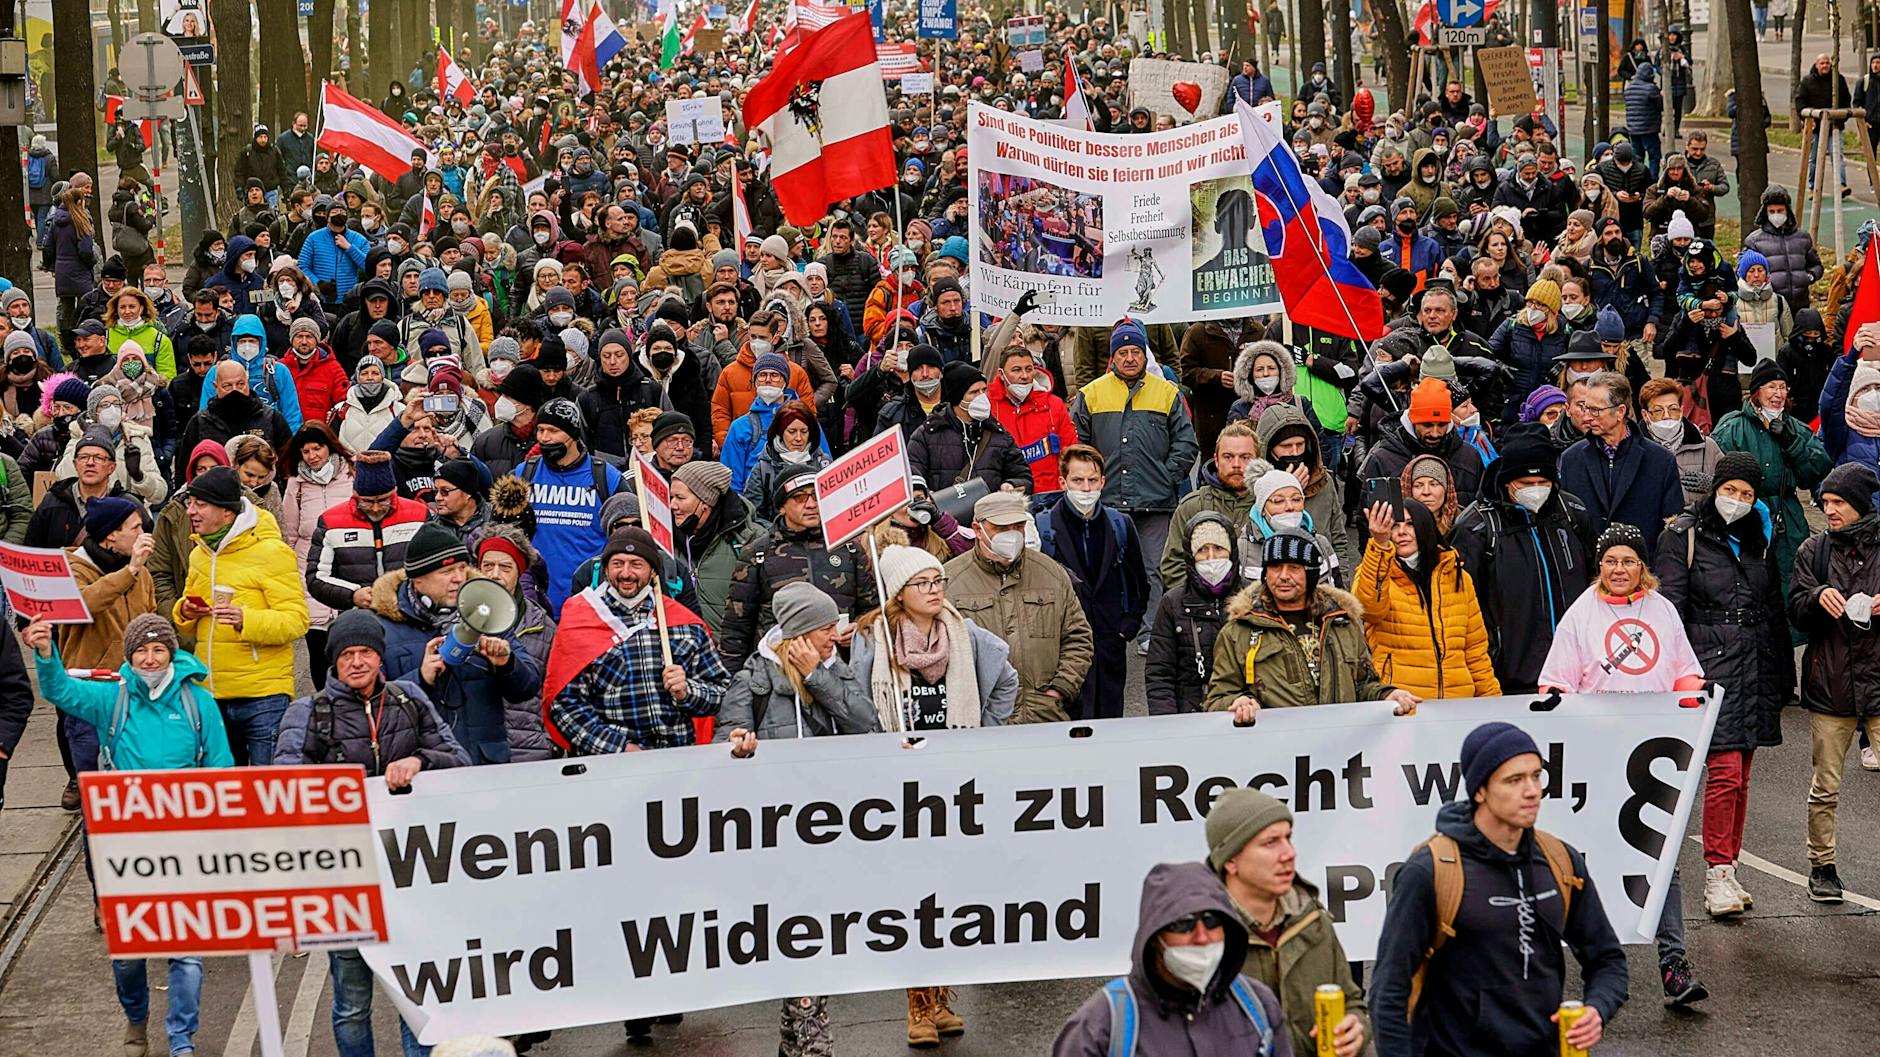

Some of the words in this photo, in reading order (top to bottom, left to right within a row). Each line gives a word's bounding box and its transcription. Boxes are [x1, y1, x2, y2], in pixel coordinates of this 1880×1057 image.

[922, 6, 946, 18] IMPF-
[922, 17, 953, 29] ZWANG!
[1445, 31, 1479, 43] 120m
[978, 111, 1005, 131] Sind
[1007, 120, 1026, 139] die
[1029, 128, 1082, 153] Politiker
[1085, 140, 1142, 158] bessere
[1147, 129, 1216, 156] Menschen
[1219, 122, 1239, 139] als
[996, 141, 1040, 166] Warum
[1043, 157, 1084, 178] dürfen
[1088, 166, 1109, 181] sie
[1113, 167, 1154, 182] feiern
[1158, 160, 1183, 178] und
[1187, 154, 1207, 171] wir
[1133, 194, 1161, 208] Friede
[1130, 209, 1164, 224] Freiheit
[1108, 226, 1186, 243] Selbstbestimmung
[1223, 247, 1249, 267] DAS
[980, 267, 1001, 285] Wir
[1003, 274, 1072, 295] Kämpfen
[1077, 282, 1102, 296] für
[1196, 265, 1276, 292] ERWACHEN
[1202, 287, 1271, 304] BEGINNT
[1089, 304, 1103, 317] !!!
[820, 442, 894, 494] NEUWAHLEN
[529, 484, 596, 507] MMUN
[854, 478, 868, 496] !!!
[847, 492, 881, 522] JETZT
[0, 552, 63, 573] EUWAHLEN
[22, 577, 37, 592] !!!
[912, 686, 937, 696] DER
[87, 775, 247, 822] HÄNDE
[253, 776, 363, 816] WEG
[378, 821, 613, 889] Wenn
[646, 778, 984, 859] Unrecht
[1014, 784, 1104, 832] zu
[1401, 742, 1588, 814] wd,
[107, 854, 182, 878] von
[197, 847, 363, 875] unseren
[115, 892, 373, 944] KINDERN
[391, 928, 574, 1006] wird
[621, 882, 1101, 979] Widerstand
